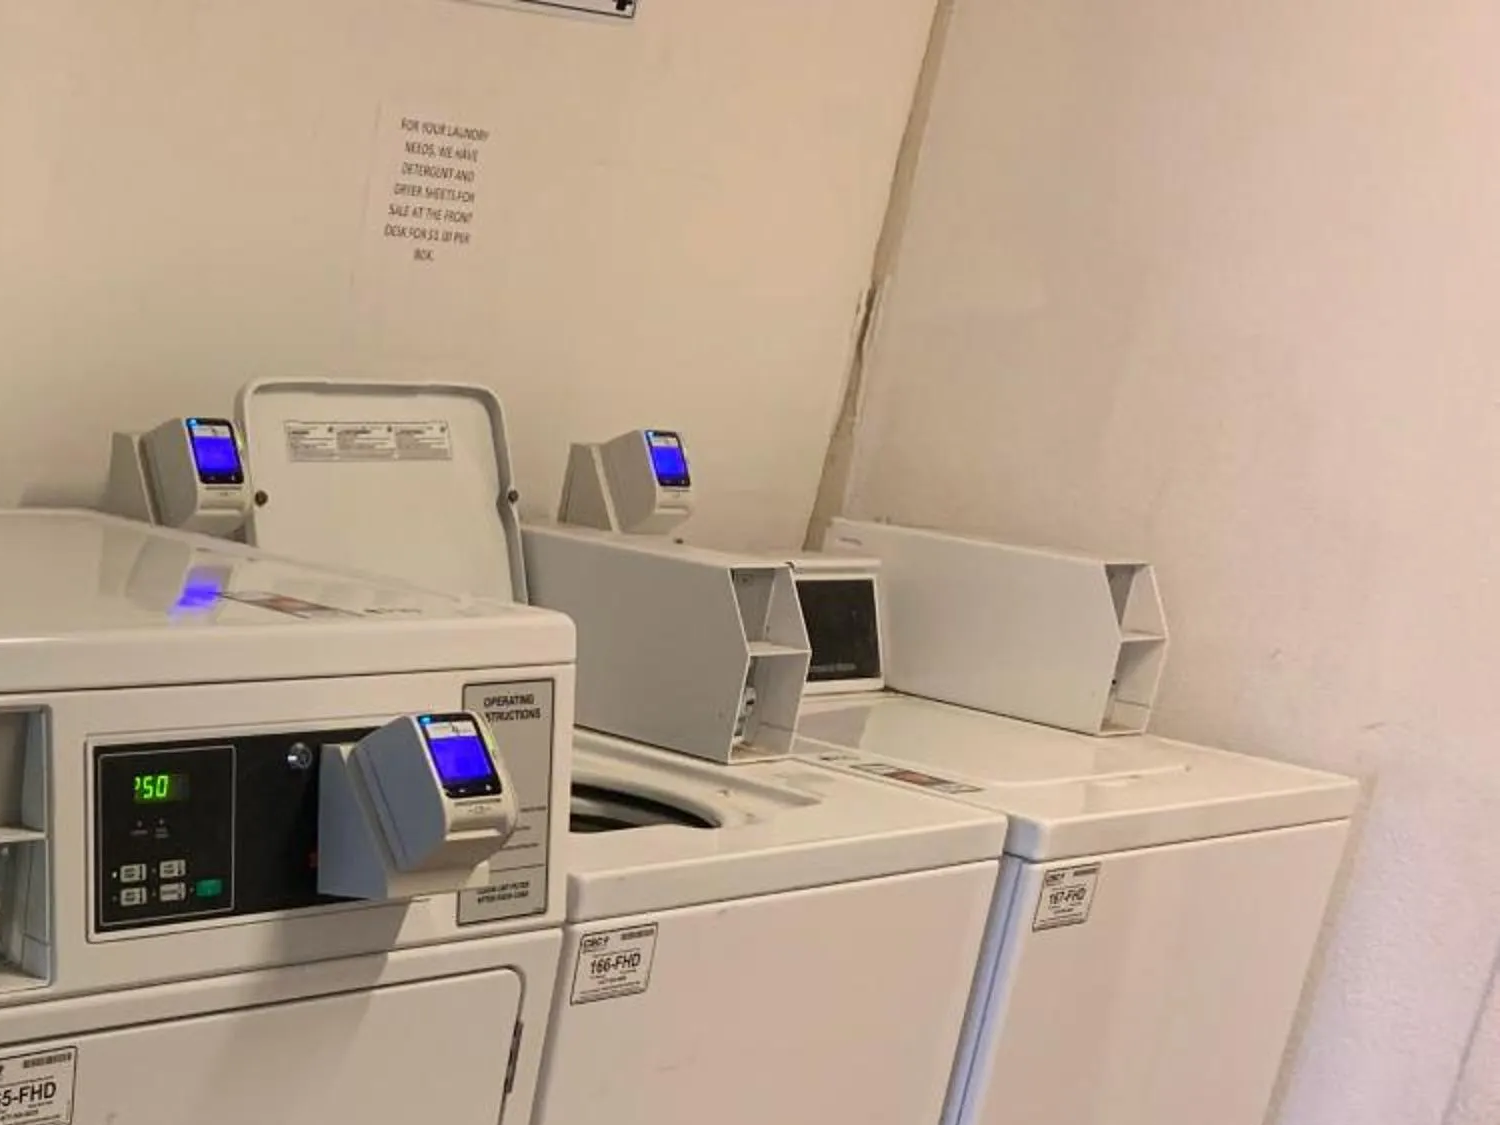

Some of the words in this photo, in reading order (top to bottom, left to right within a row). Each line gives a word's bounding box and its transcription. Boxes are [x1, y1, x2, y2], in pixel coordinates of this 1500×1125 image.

[401, 117, 419, 132] FOR
[455, 168, 475, 182] AND
[388, 203, 409, 217] SALE
[411, 206, 424, 219] AT
[425, 207, 442, 221] THE
[483, 693, 535, 708] OPERATING
[485, 707, 541, 723] STRUCTIONS
